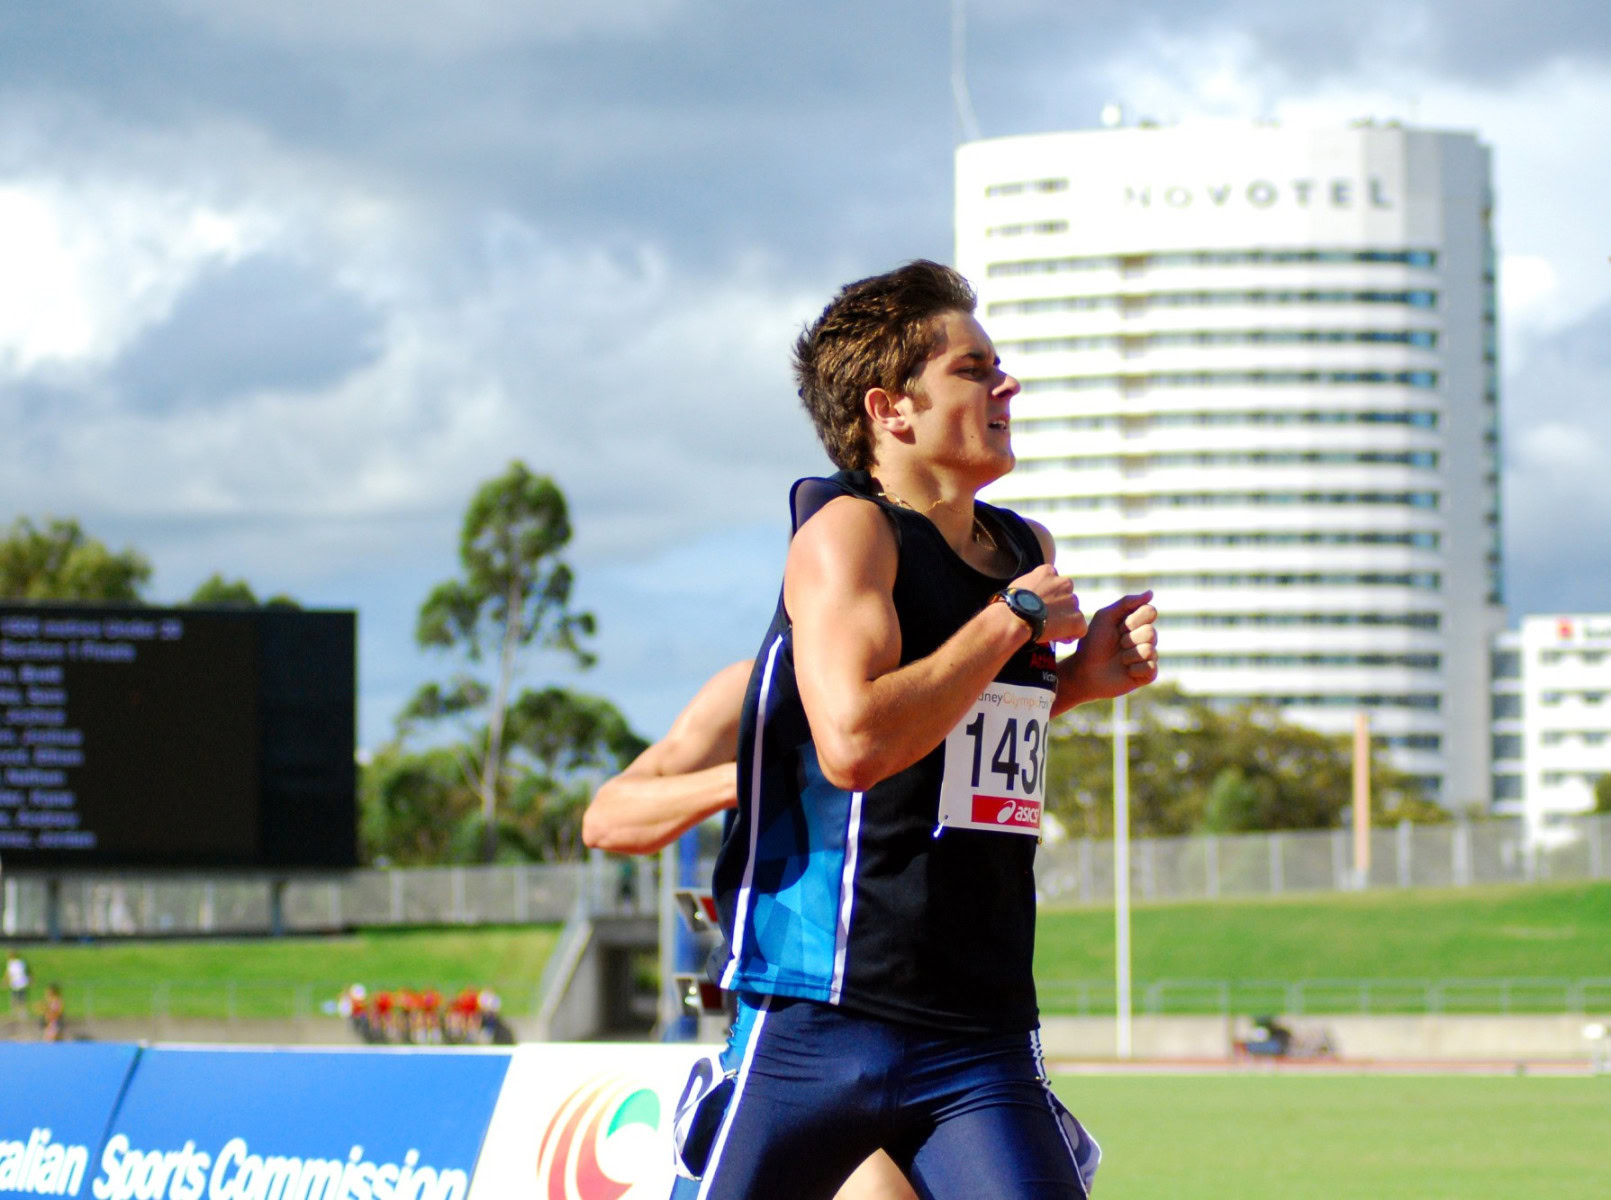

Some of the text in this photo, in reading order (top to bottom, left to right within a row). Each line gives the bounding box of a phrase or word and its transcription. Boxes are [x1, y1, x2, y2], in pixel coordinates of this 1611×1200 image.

[1123, 174, 1395, 211] NOVOTEL
[92, 1133, 211, 1200] Sports
[208, 1137, 468, 1200] Commission
